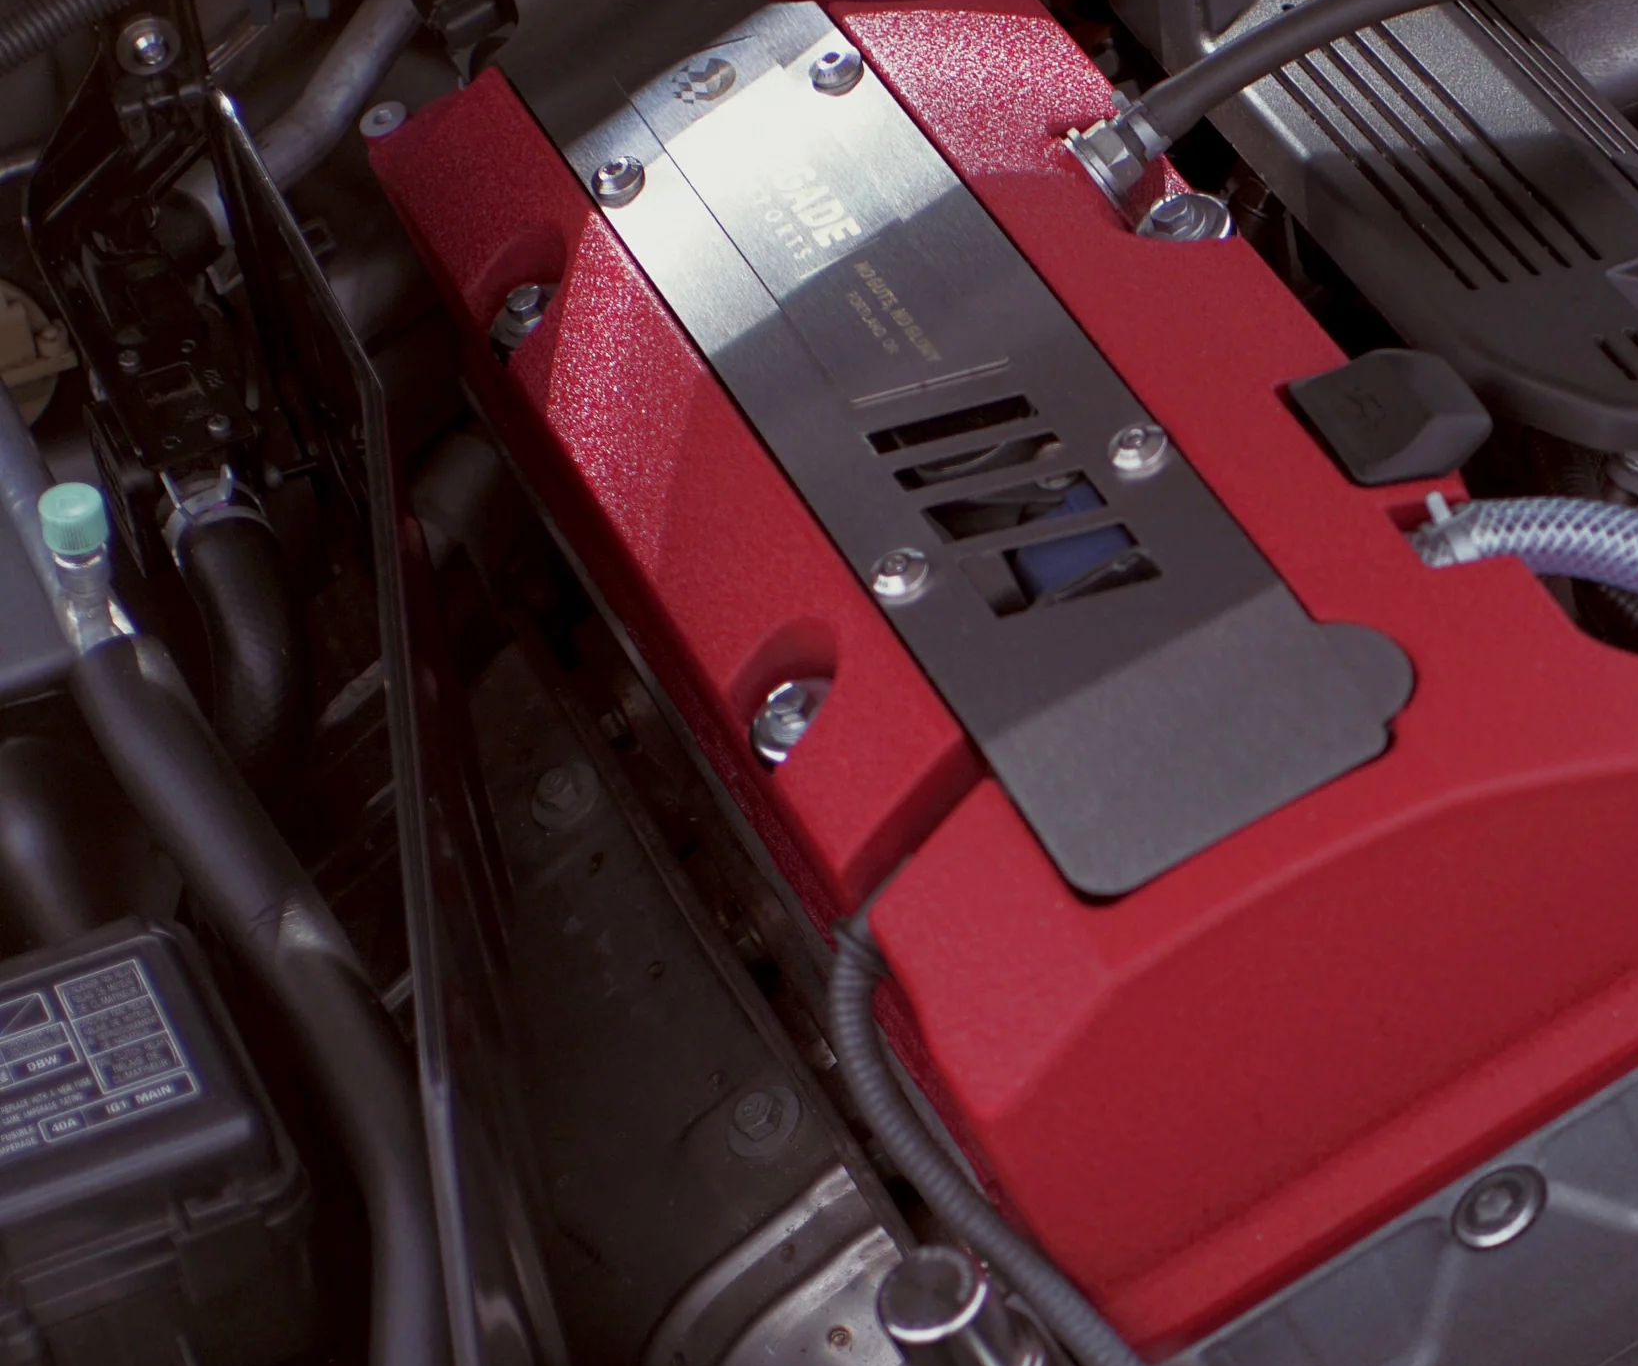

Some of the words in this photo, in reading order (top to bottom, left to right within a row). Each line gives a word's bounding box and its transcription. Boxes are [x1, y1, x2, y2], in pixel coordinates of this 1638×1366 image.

[27, 1054, 59, 1072] DBW
[51, 1117, 77, 1133] 40A
[134, 1083, 173, 1104] MAIN
[0, 1135, 37, 1155] MPERAGE
